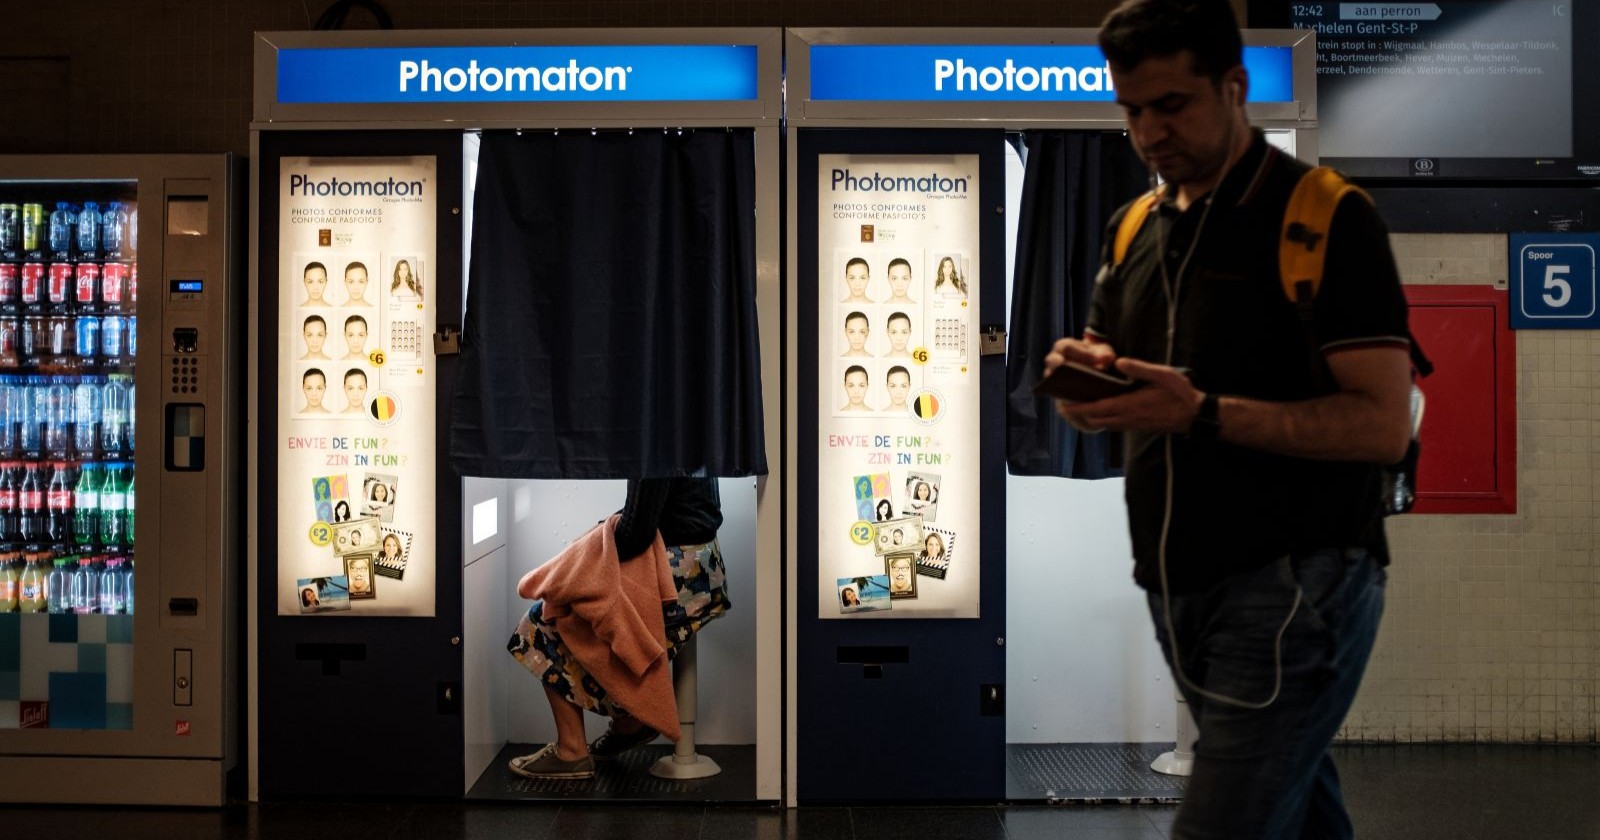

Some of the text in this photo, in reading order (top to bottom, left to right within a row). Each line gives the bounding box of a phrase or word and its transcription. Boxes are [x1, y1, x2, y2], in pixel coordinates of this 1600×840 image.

[1292, 5, 1322, 16] 12:42
[1355, 7, 1420, 18] aan perron
[1553, 5, 1565, 16] IC
[1293, 22, 1418, 34] Mchelen Gent-St-P
[1318, 41, 1339, 49] trein
[1342, 42, 1365, 52] stopt
[1367, 41, 1376, 49] in
[1384, 41, 1427, 52] Wijgmaal,
[1331, 54, 1402, 63] Boortmeerbeek,
[1474, 54, 1520, 63] Mechelen,
[400, 59, 626, 92] Photomaton
[934, 59, 1113, 92] Photomat
[1316, 66, 1346, 75] erzeel,
[1348, 66, 1414, 75] Dendermonde,
[290, 174, 422, 196] Photomaton
[832, 169, 967, 192] Photomaton
[1528, 251, 1554, 260] Spoor
[1542, 265, 1572, 308] 5
[370, 353, 384, 364] €6
[913, 351, 928, 362] €6
[288, 437, 327, 449] ENVIE
[332, 438, 348, 449] DE
[354, 438, 378, 449] FUN
[829, 435, 869, 447] ENVIE
[875, 435, 891, 448] DE
[897, 436, 921, 447] FUN
[326, 455, 348, 466] ZIN
[354, 455, 368, 466] IN
[374, 455, 398, 466] FUN
[868, 453, 891, 464] ZIN
[897, 453, 911, 464] IN
[917, 453, 941, 464] FUN
[313, 528, 328, 542] €2
[854, 527, 869, 540] €2
